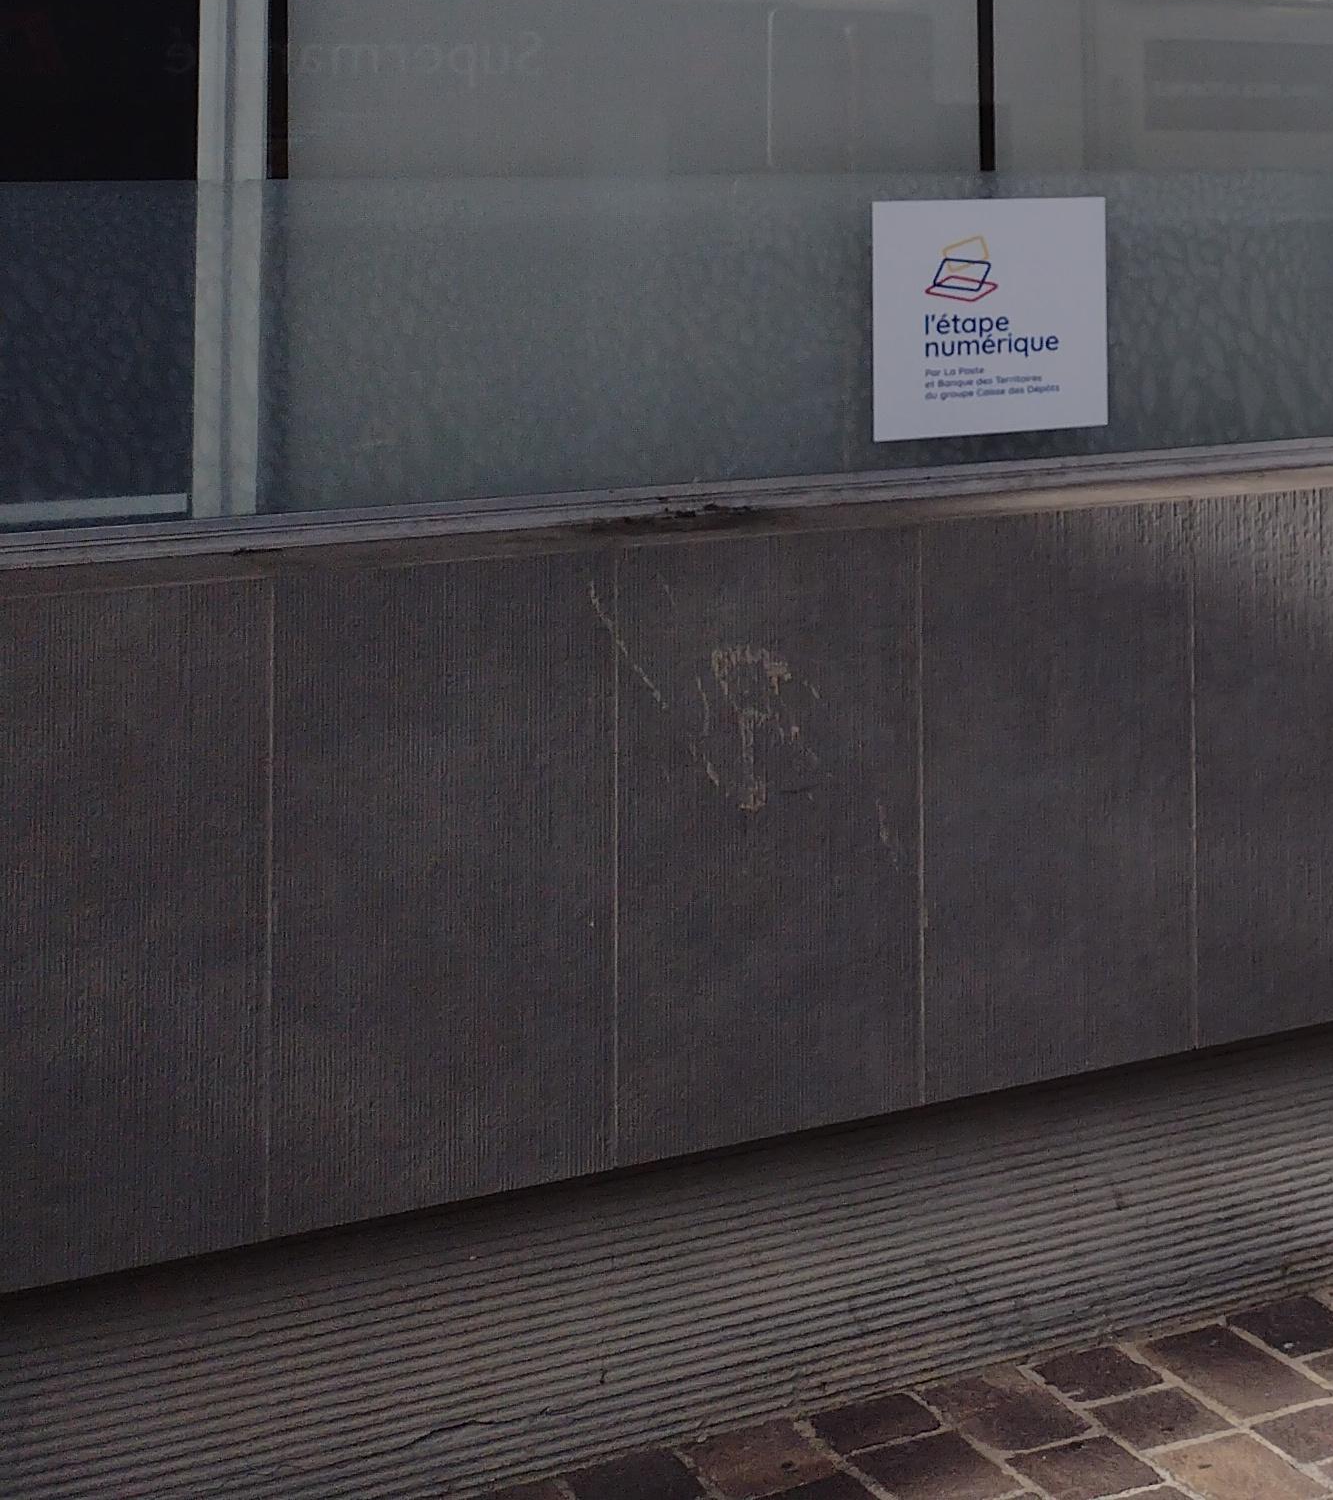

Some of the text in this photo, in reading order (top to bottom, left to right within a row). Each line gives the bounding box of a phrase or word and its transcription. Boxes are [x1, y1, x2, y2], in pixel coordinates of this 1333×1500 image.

[924, 313, 1009, 337] l'étape
[924, 332, 1060, 358] numérique
[925, 366, 985, 377] Par La Poste
[925, 374, 1043, 389] et Banque des Territoires
[925, 391, 937, 400] du
[939, 389, 974, 401] groupe
[1008, 385, 1025, 394] des
[1027, 382, 1061, 394] Dépôts
